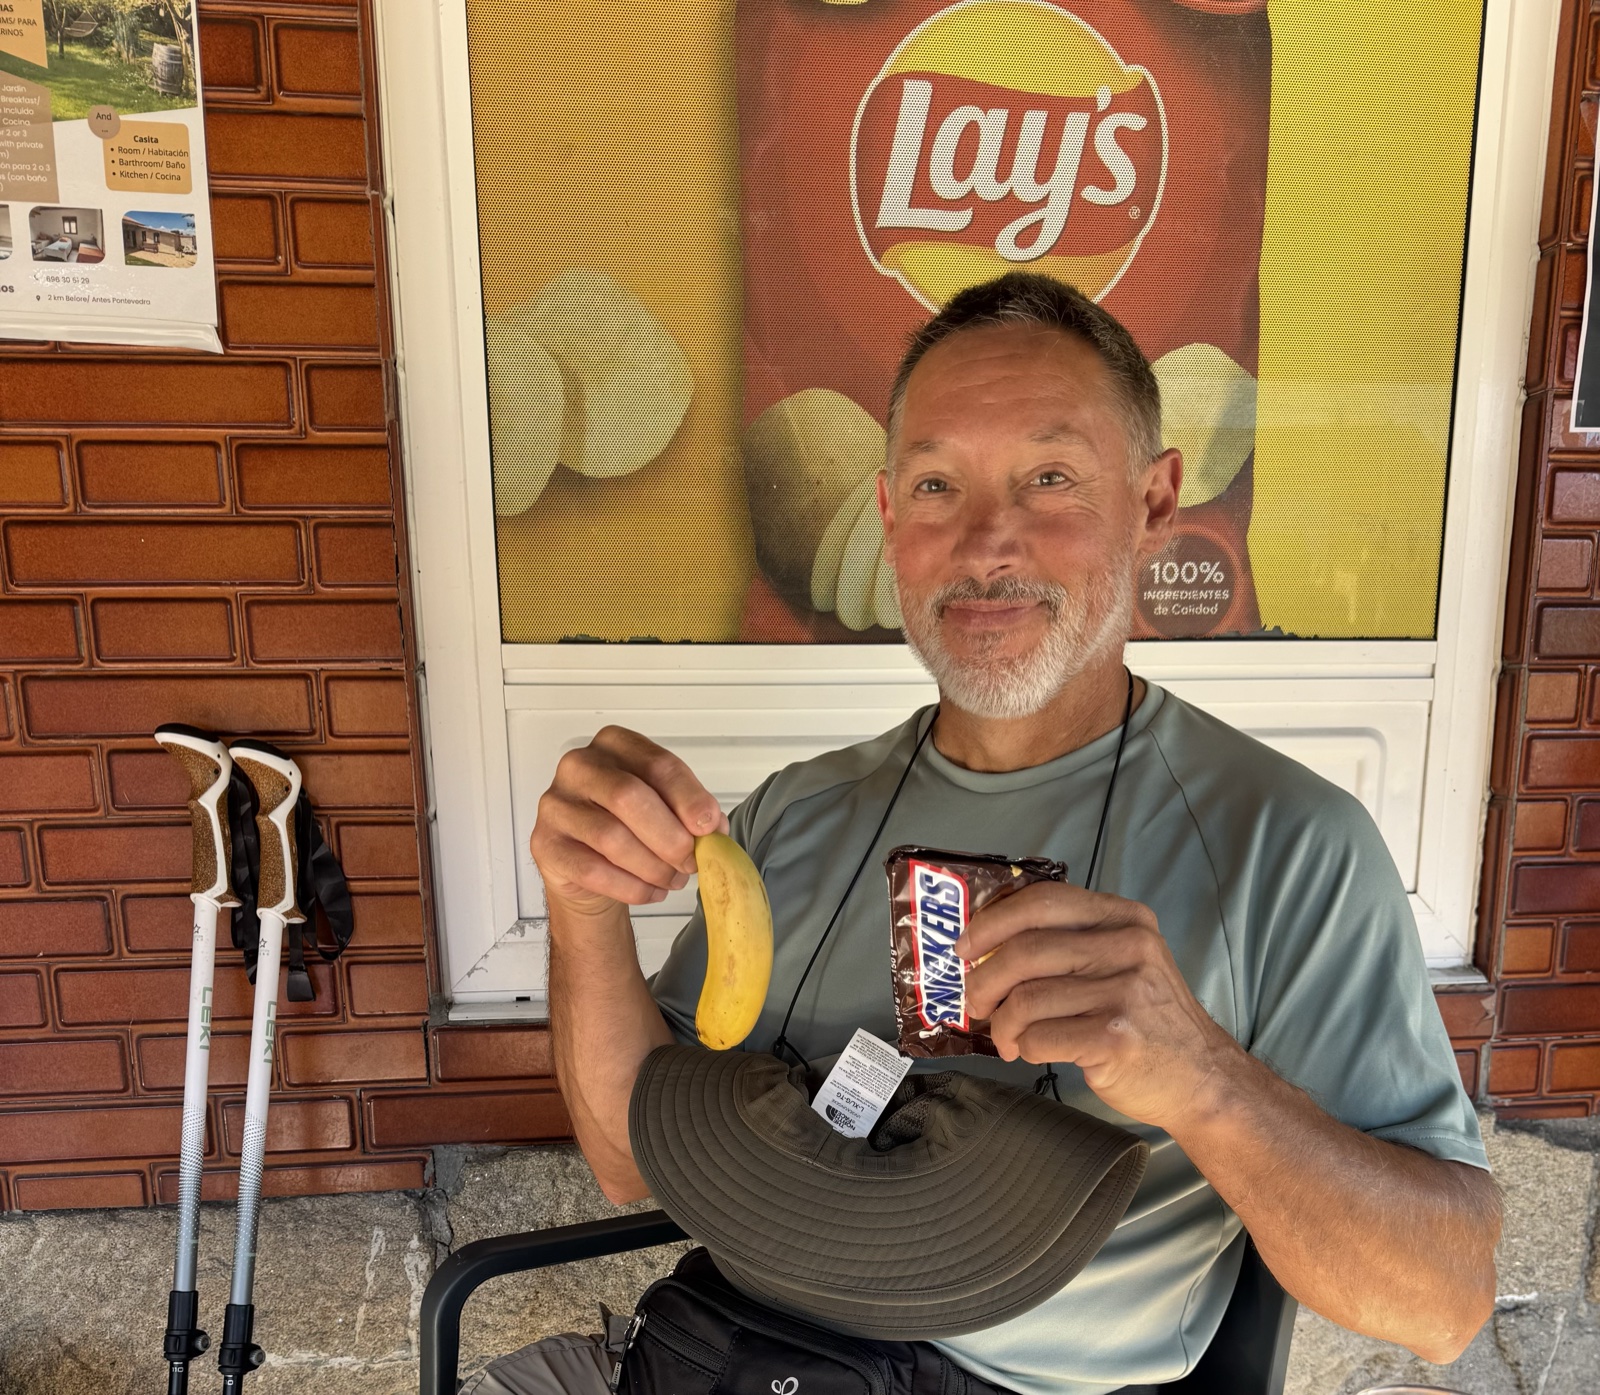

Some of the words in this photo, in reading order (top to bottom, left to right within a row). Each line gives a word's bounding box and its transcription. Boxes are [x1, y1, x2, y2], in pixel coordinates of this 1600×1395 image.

[18, 18, 37, 26] PARA
[1, 28, 24, 36] RINOS
[4, 107, 34, 115] Incluido
[134, 135, 159, 144] Casita
[16, 141, 43, 149] private
[118, 146, 140, 155] Room
[148, 148, 189, 157] Habitación
[119, 159, 164, 168] Barthroom/
[166, 161, 185, 169] Baño
[120, 171, 148, 179] Kitchen
[155, 172, 181, 181] Cocina
[876, 80, 1148, 262] Lay's
[8, 172, 25, 182] (con
[27, 174, 47, 182] baño
[0, 285, 14, 293] os
[1150, 561, 1224, 584] 100%
[1144, 590, 1229, 600] INGREDIENTES
[1154, 604, 1168, 615] de
[1172, 603, 1218, 615] Calidad
[919, 872, 964, 1024] SNICKERS
[200, 986, 212, 1050] LEKI
[264, 1000, 277, 1063] LEKI
[836, 1092, 864, 1111] L-XL/G-TG
[837, 1112, 852, 1122] FACE
[833, 1119, 844, 1127] THE
[835, 1116, 855, 1130] NORTH
